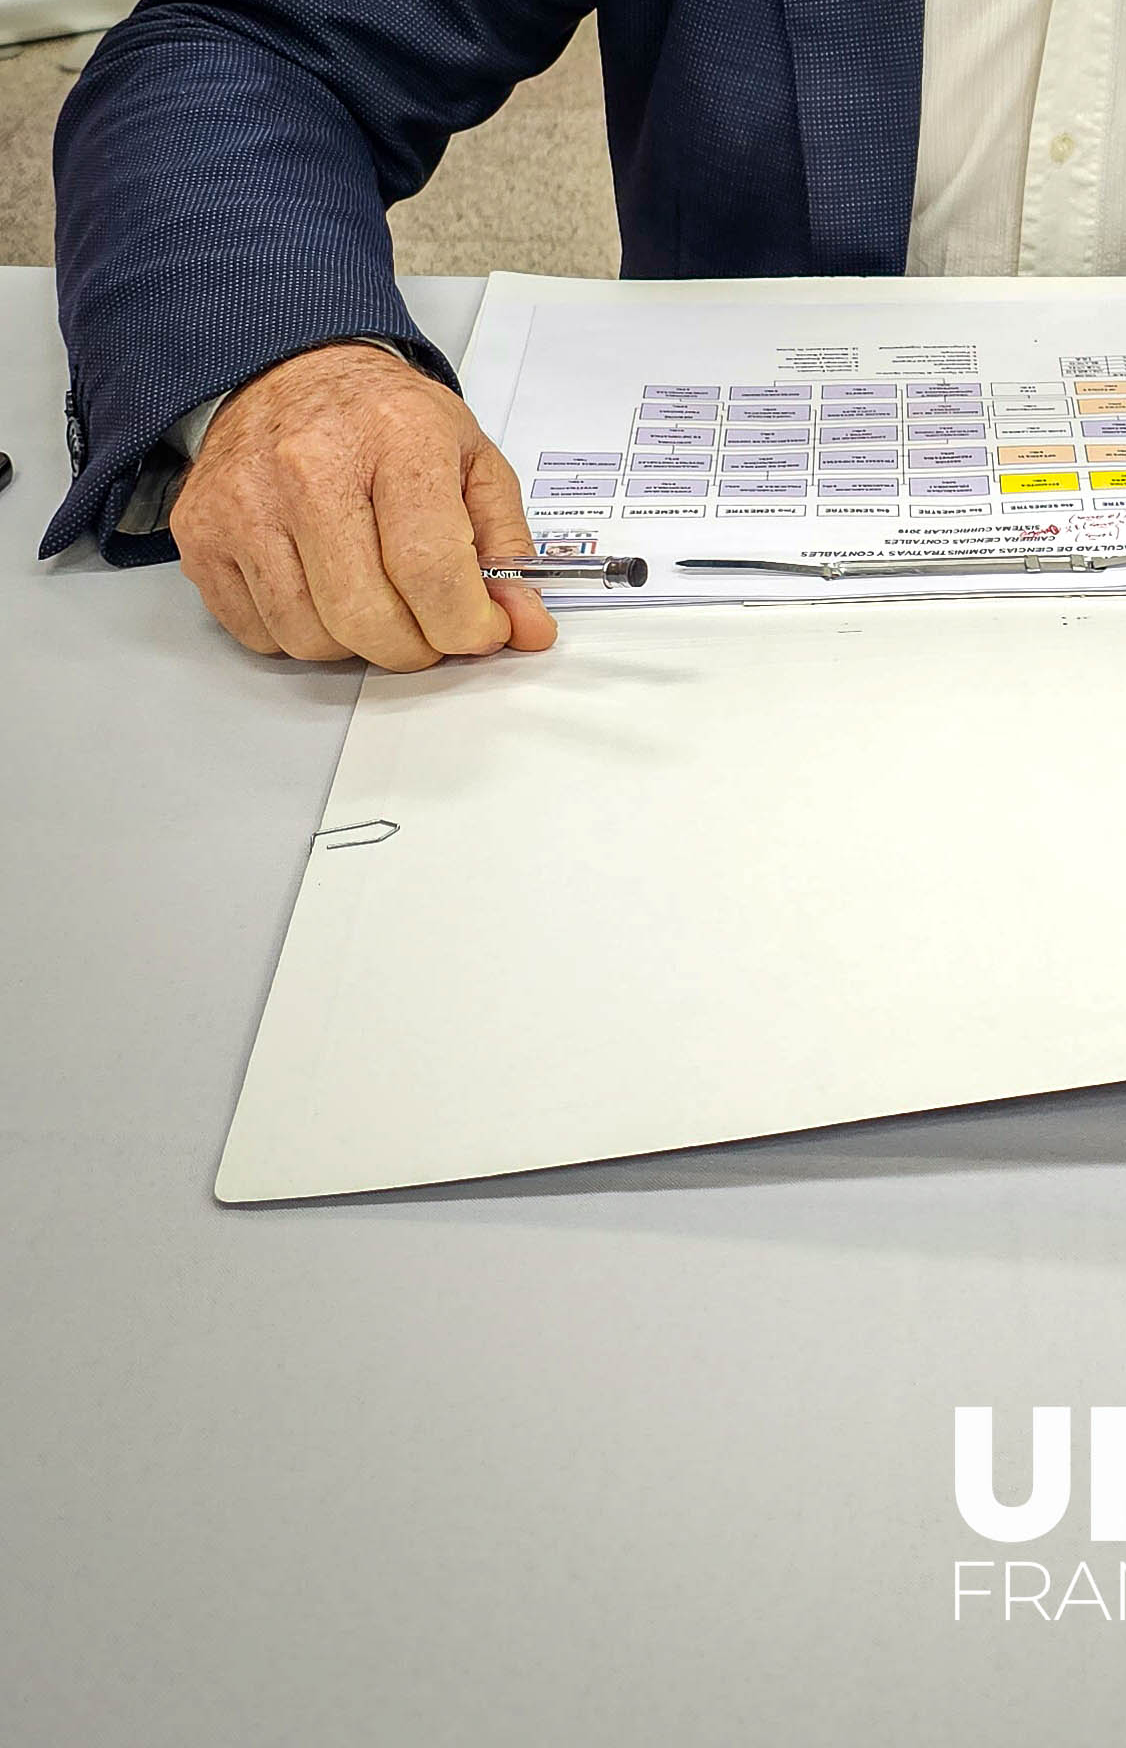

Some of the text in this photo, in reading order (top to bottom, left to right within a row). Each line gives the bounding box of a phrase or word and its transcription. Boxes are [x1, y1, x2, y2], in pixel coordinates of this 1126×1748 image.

[800, 550, 873, 558] CONTABLES
[888, 548, 996, 556] ADMINISTRATIVAS
[1000, 546, 1054, 554] CIENCIAS
